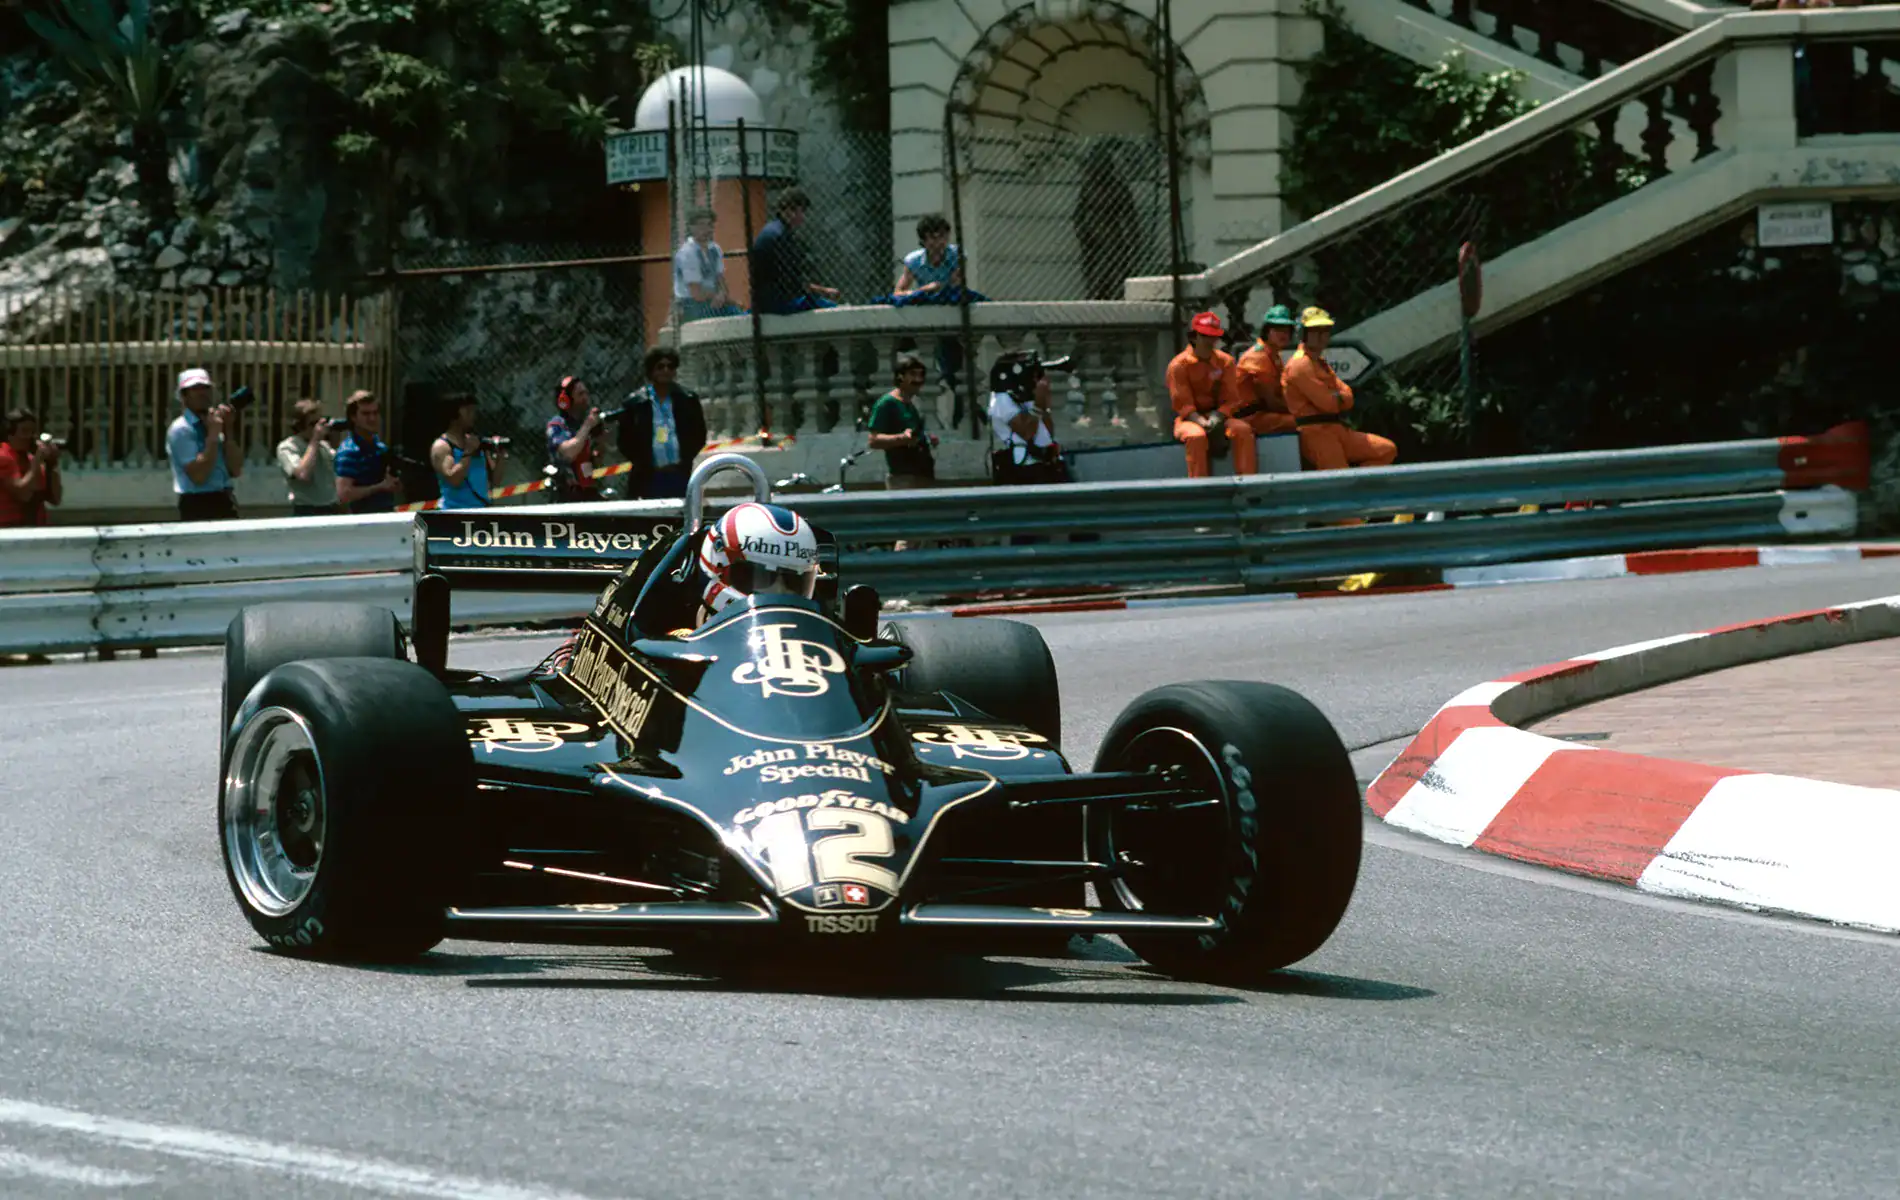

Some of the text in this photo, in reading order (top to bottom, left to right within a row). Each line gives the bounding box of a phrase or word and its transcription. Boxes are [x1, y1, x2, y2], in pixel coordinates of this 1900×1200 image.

[453, 521, 536, 549] John
[541, 521, 647, 553] Player
[739, 535, 780, 556] John
[723, 743, 896, 776] John Player
[759, 762, 873, 784] Special
[732, 789, 910, 825] GOODYEAR
[750, 806, 900, 898] 12
[804, 914, 880, 933] TISSOT
